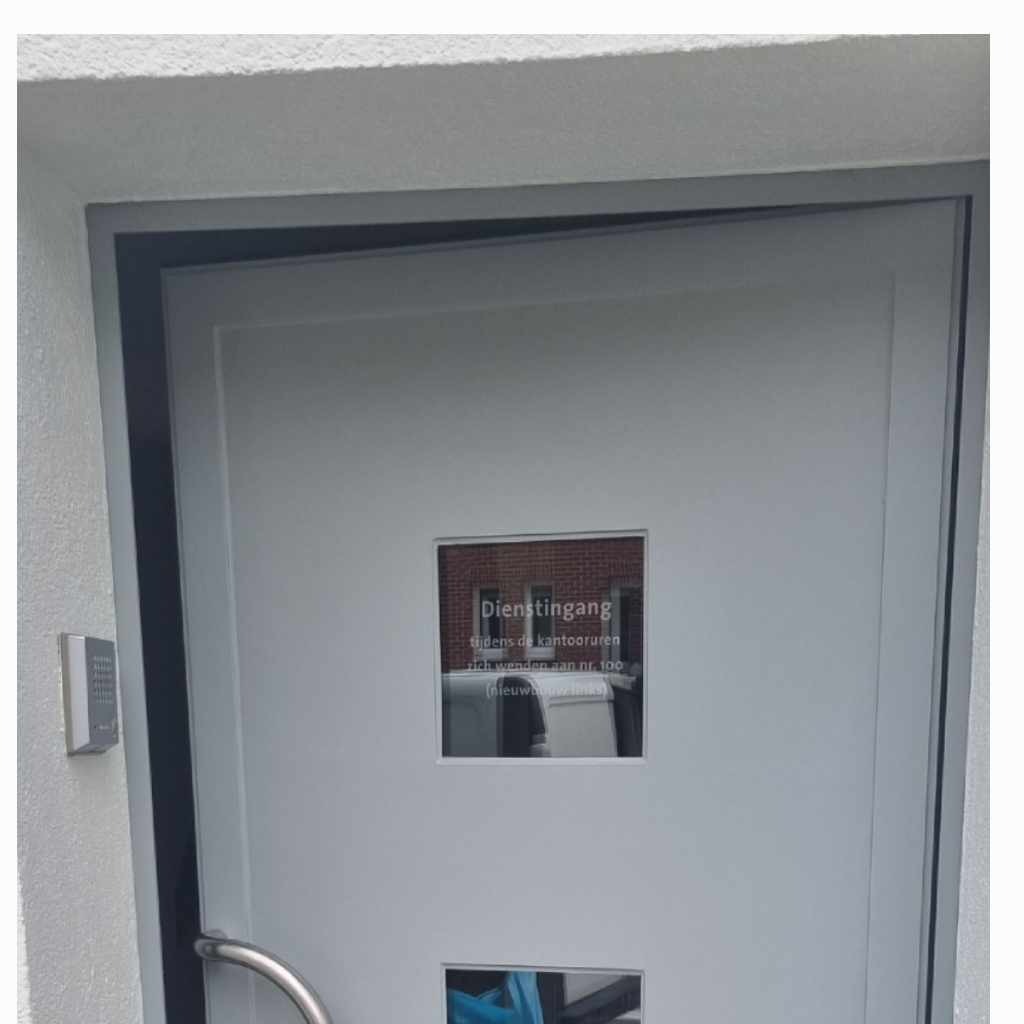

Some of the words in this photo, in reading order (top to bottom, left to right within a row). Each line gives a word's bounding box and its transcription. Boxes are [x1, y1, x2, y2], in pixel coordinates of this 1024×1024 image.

[482, 599, 613, 621] Dienstingang
[470, 635, 515, 649] tijdens
[518, 634, 534, 647] de
[537, 632, 621, 647] kantooruren
[551, 662, 576, 672] aan
[601, 661, 624, 671] 100
